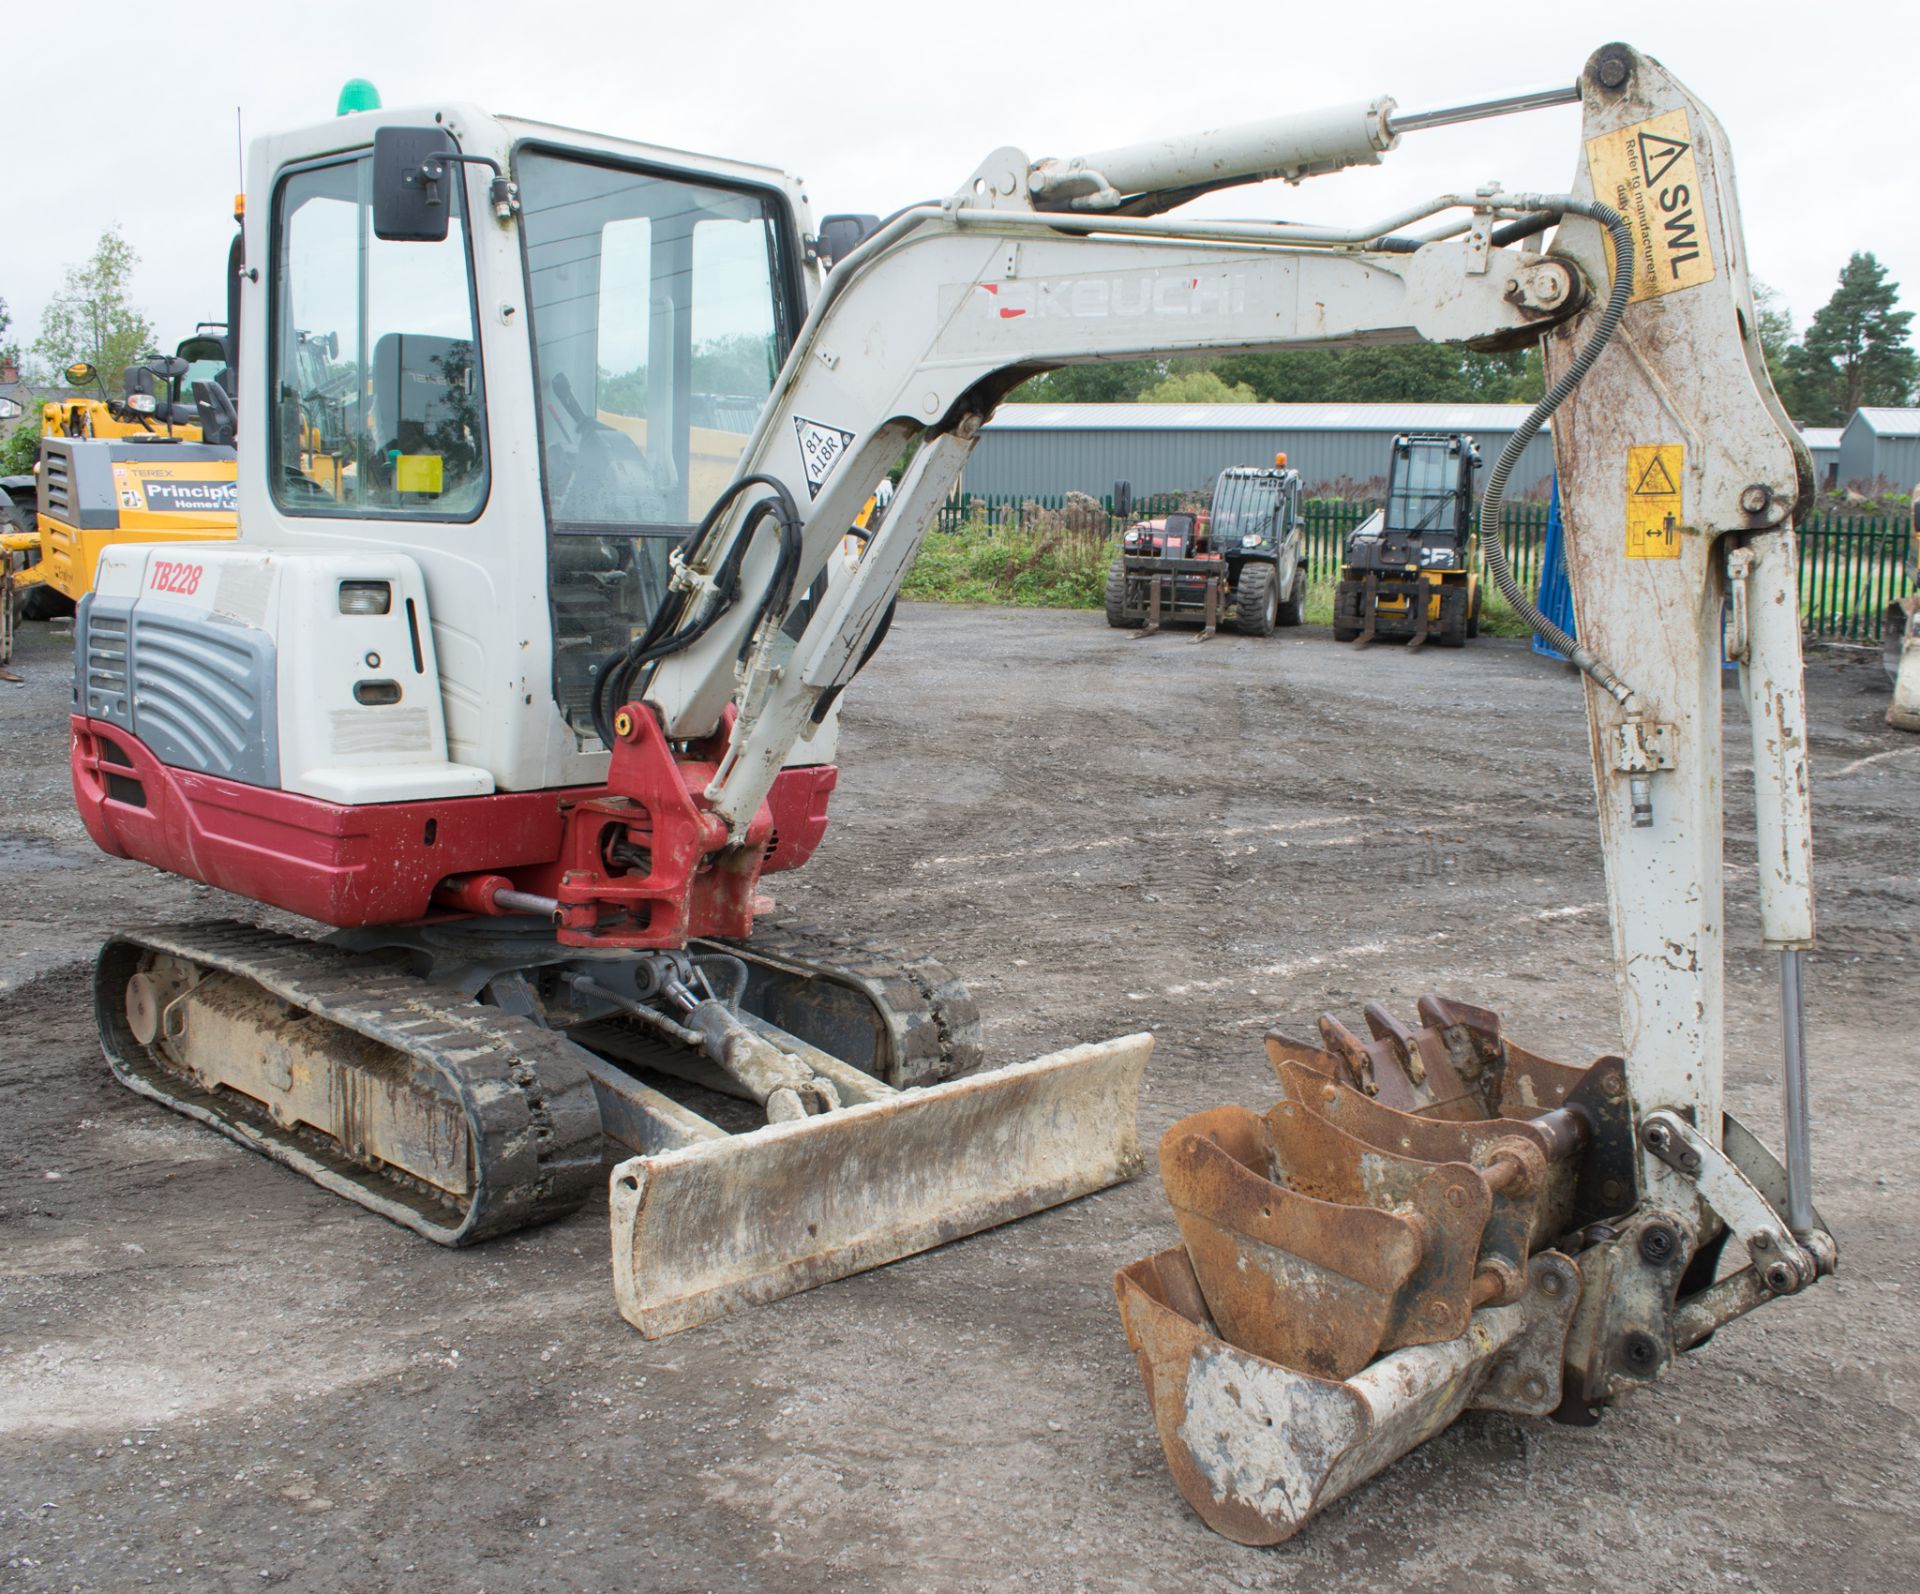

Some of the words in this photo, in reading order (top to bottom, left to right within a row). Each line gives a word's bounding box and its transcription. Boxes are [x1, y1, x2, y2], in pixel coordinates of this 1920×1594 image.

[1626, 138, 1639, 173] Refer
[1632, 174, 1642, 190] to
[1617, 184, 1630, 212] duty
[1635, 191, 1658, 283] manufacturers
[1659, 184, 1700, 280] SWL
[805, 431, 823, 455] 81
[131, 469, 174, 478] TEREX
[223, 500, 238, 509] Lt
[150, 560, 204, 596] TB228
